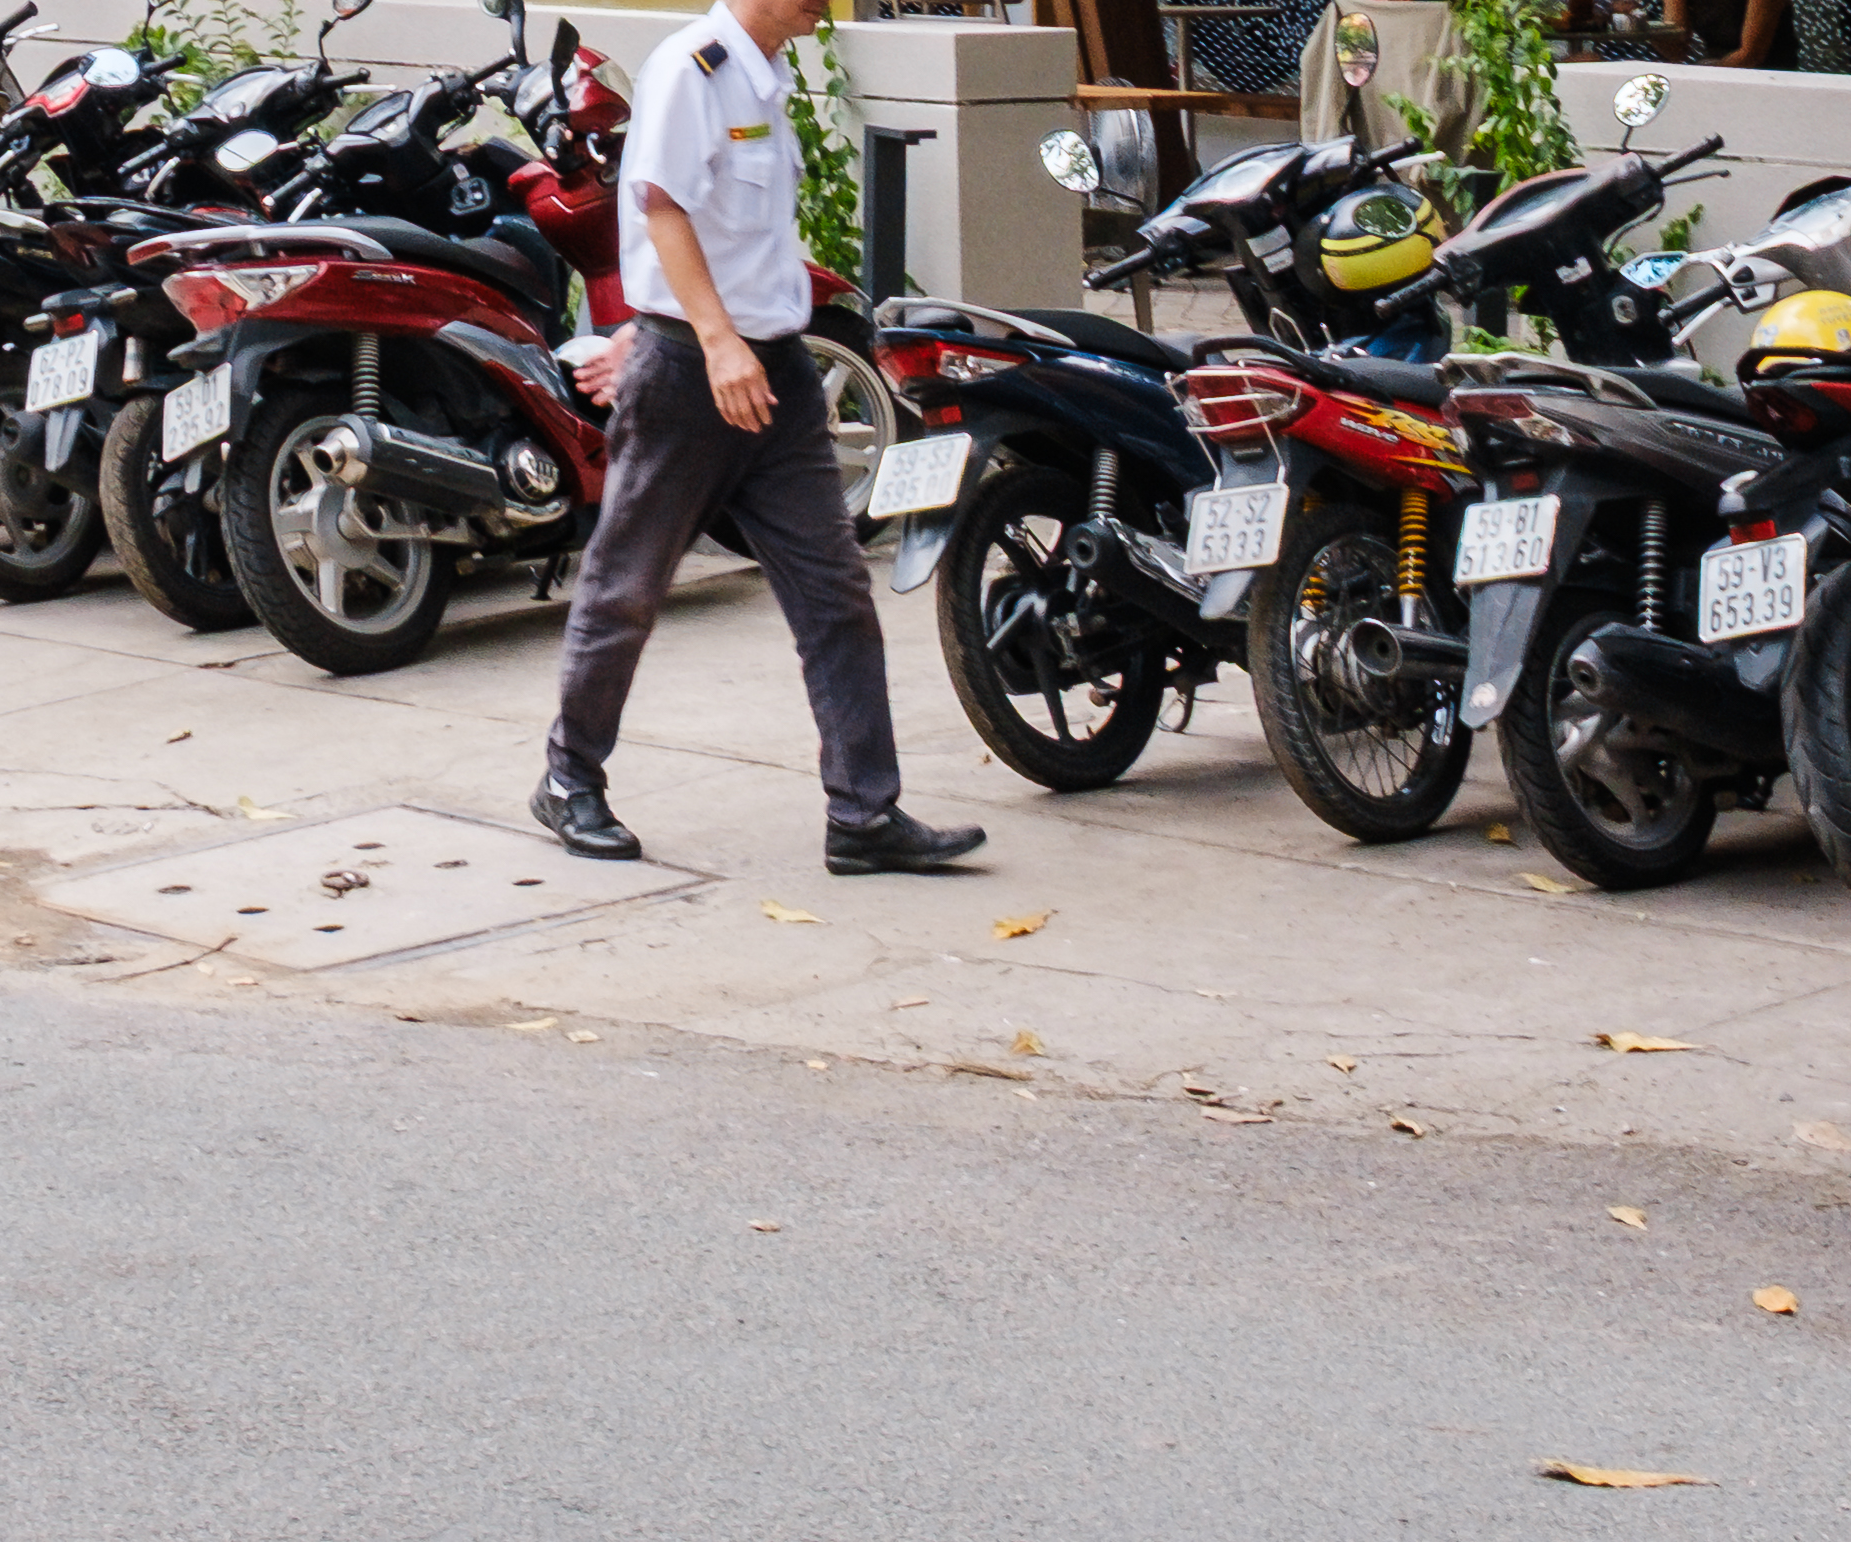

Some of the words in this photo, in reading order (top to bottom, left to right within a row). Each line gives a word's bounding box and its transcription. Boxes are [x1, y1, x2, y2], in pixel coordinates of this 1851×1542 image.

[1206, 491, 1271, 530] 52-S2
[1460, 535, 1544, 576] 513.60
[1717, 545, 1787, 592] 59-V3
[1710, 583, 1794, 633] 653.39
